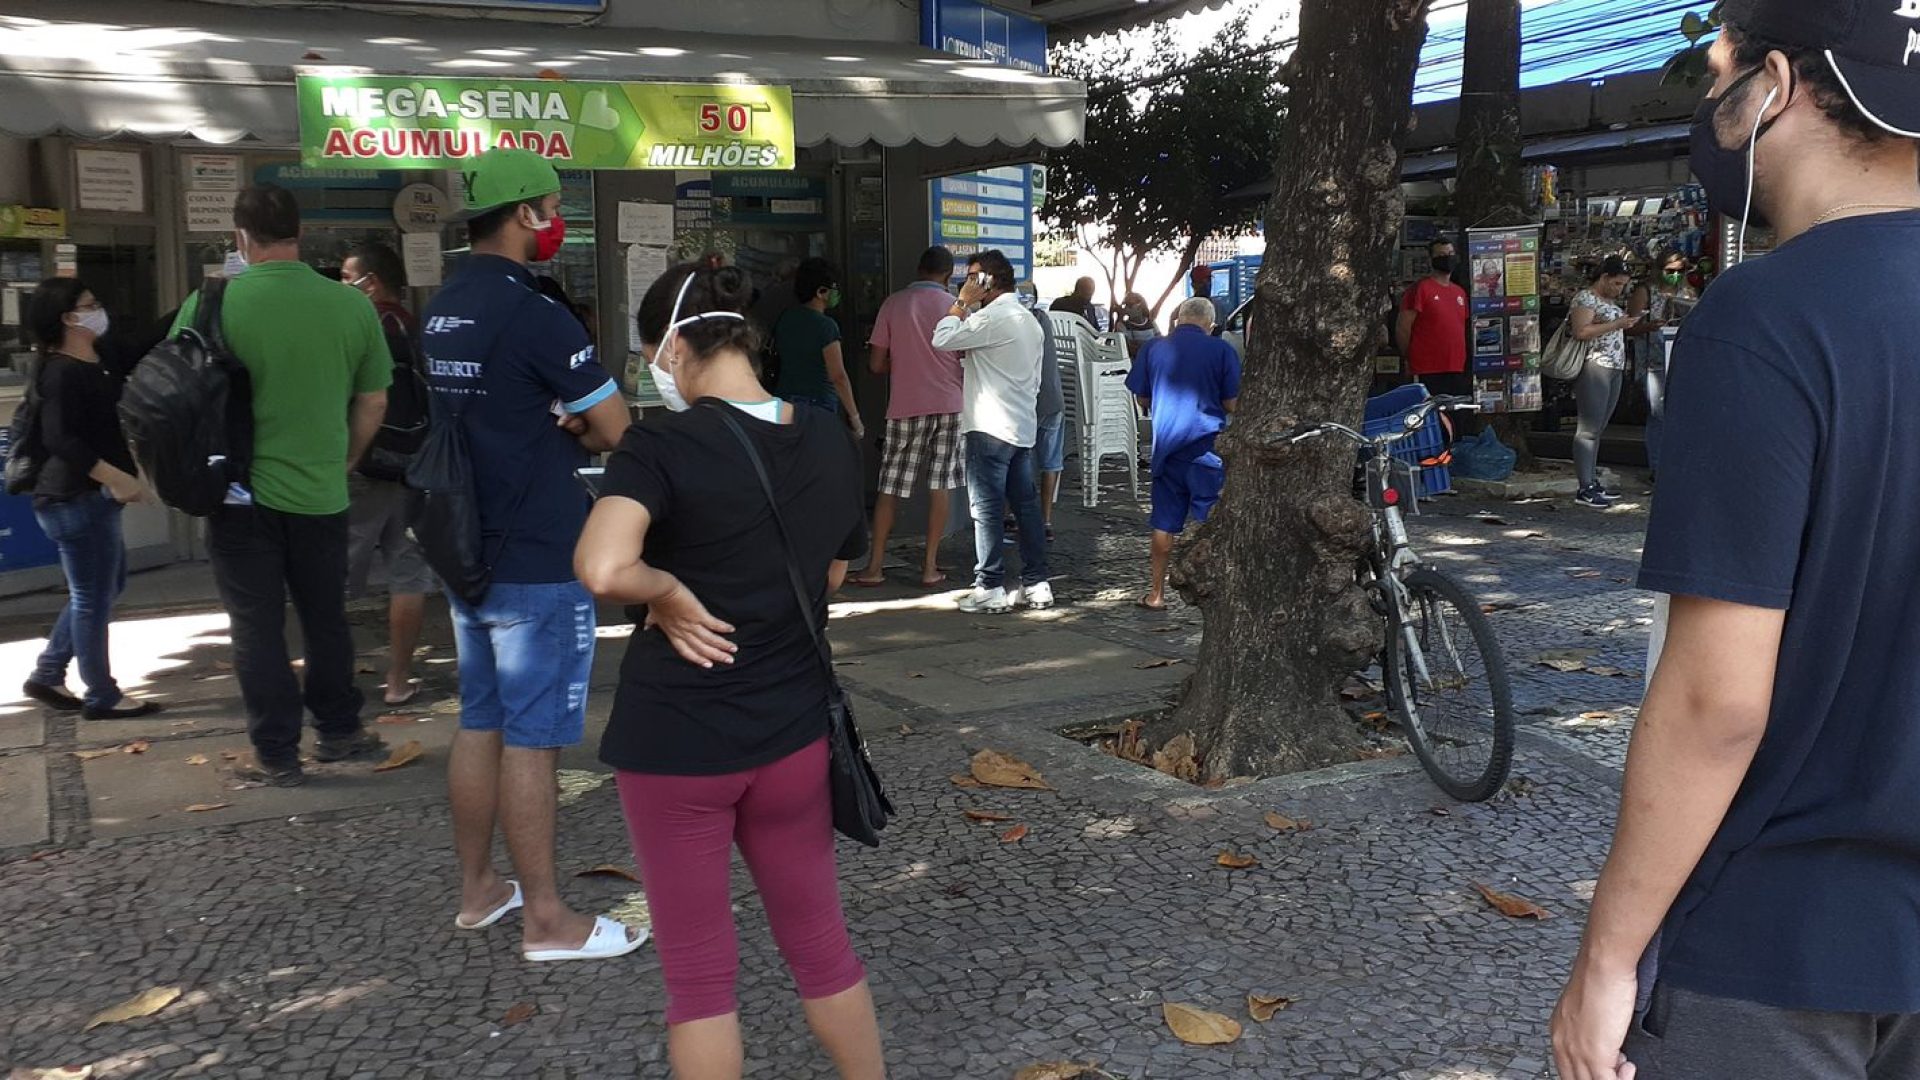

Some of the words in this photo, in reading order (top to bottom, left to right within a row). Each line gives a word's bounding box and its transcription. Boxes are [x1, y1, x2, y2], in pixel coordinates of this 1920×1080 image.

[320, 86, 570, 122] MEGA-SENA
[699, 102, 748, 134] 50
[322, 127, 573, 159] ACUMULADA
[648, 142, 779, 168] MILHÕES
[730, 175, 809, 189] ACUMULADA
[414, 191, 433, 204] FILA
